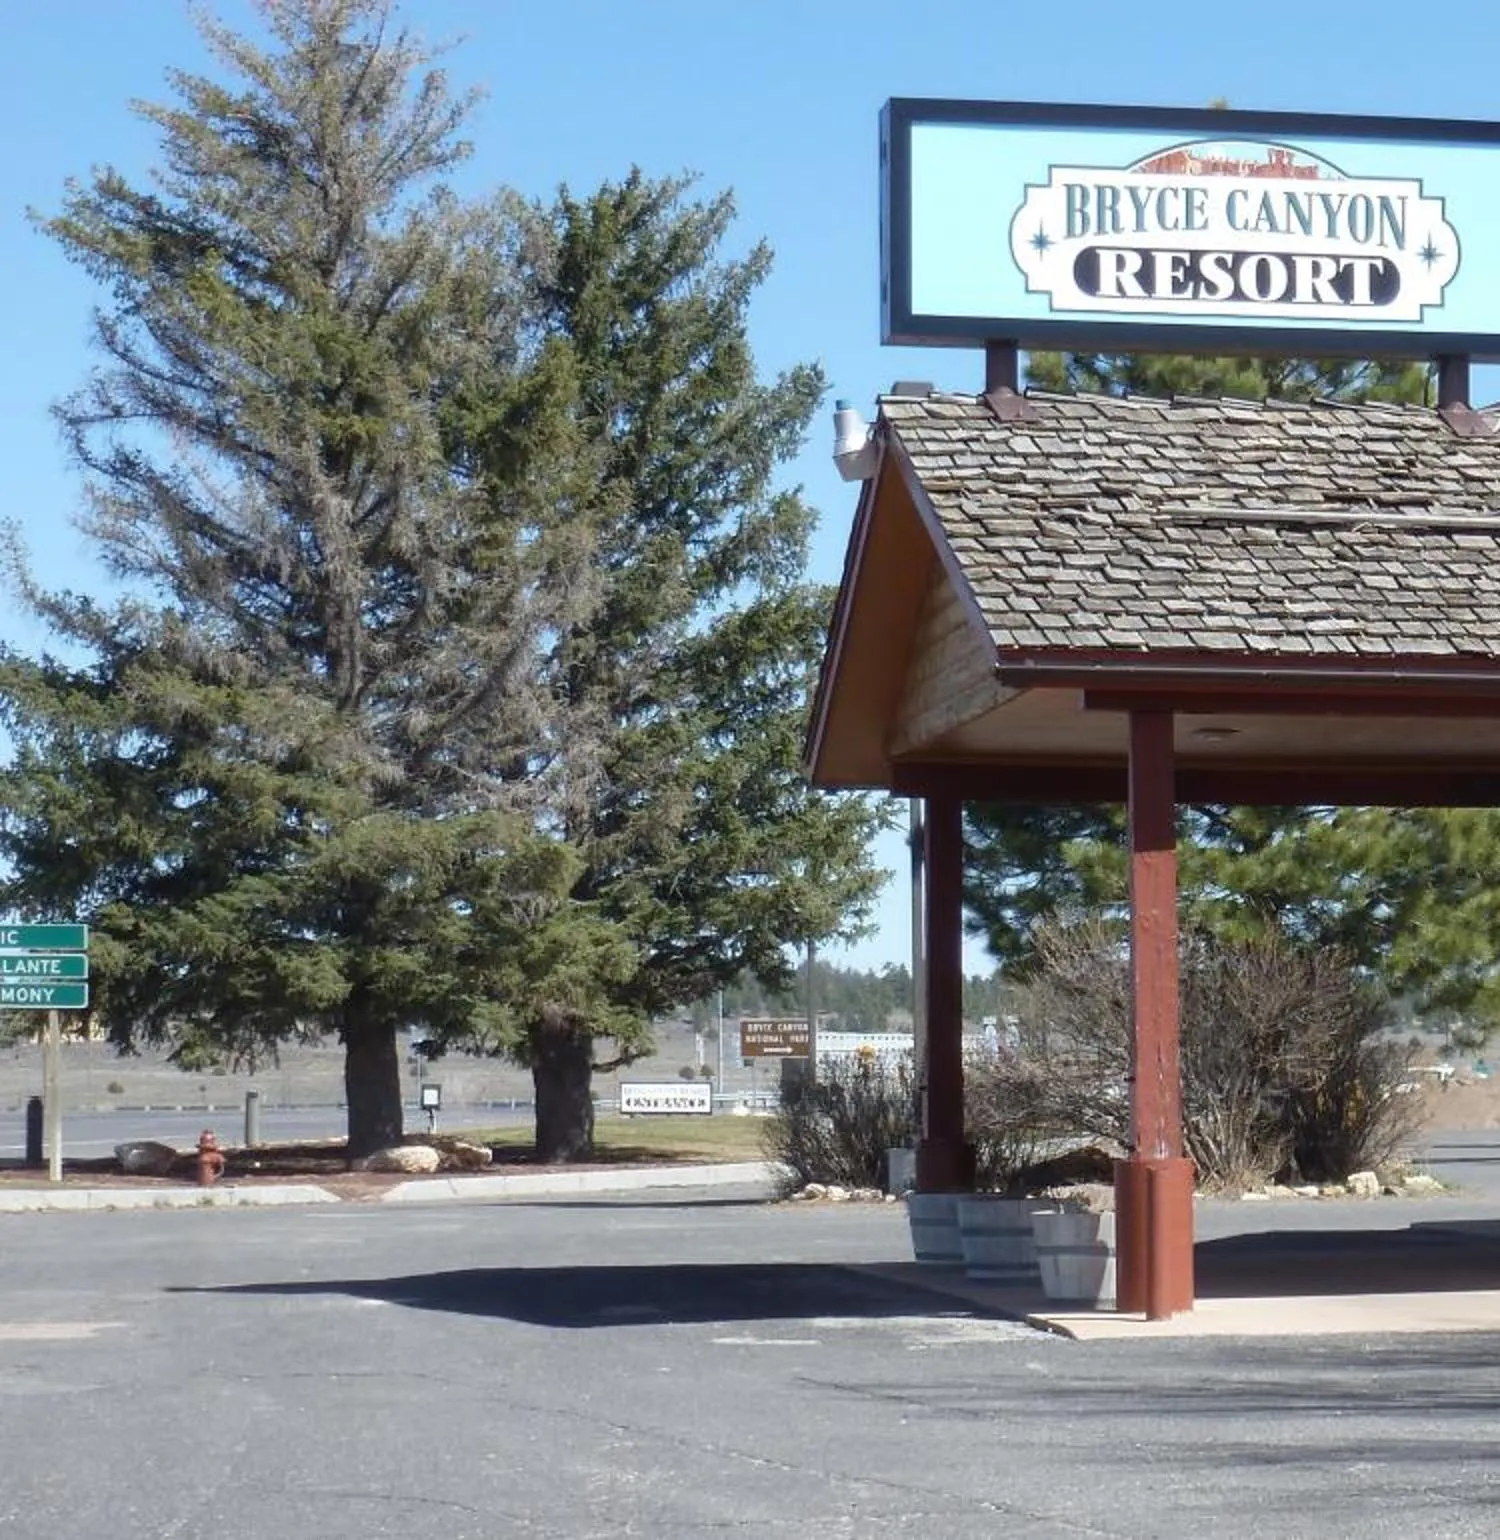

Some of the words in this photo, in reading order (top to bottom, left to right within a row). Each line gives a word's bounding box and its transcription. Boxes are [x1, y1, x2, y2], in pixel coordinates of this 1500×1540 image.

[1063, 183, 1209, 240] BRYCE
[1225, 189, 1408, 250] CANYON
[1095, 249, 1385, 305] RESORT
[3, 960, 61, 973] LANTE
[1, 987, 55, 1002] MONY
